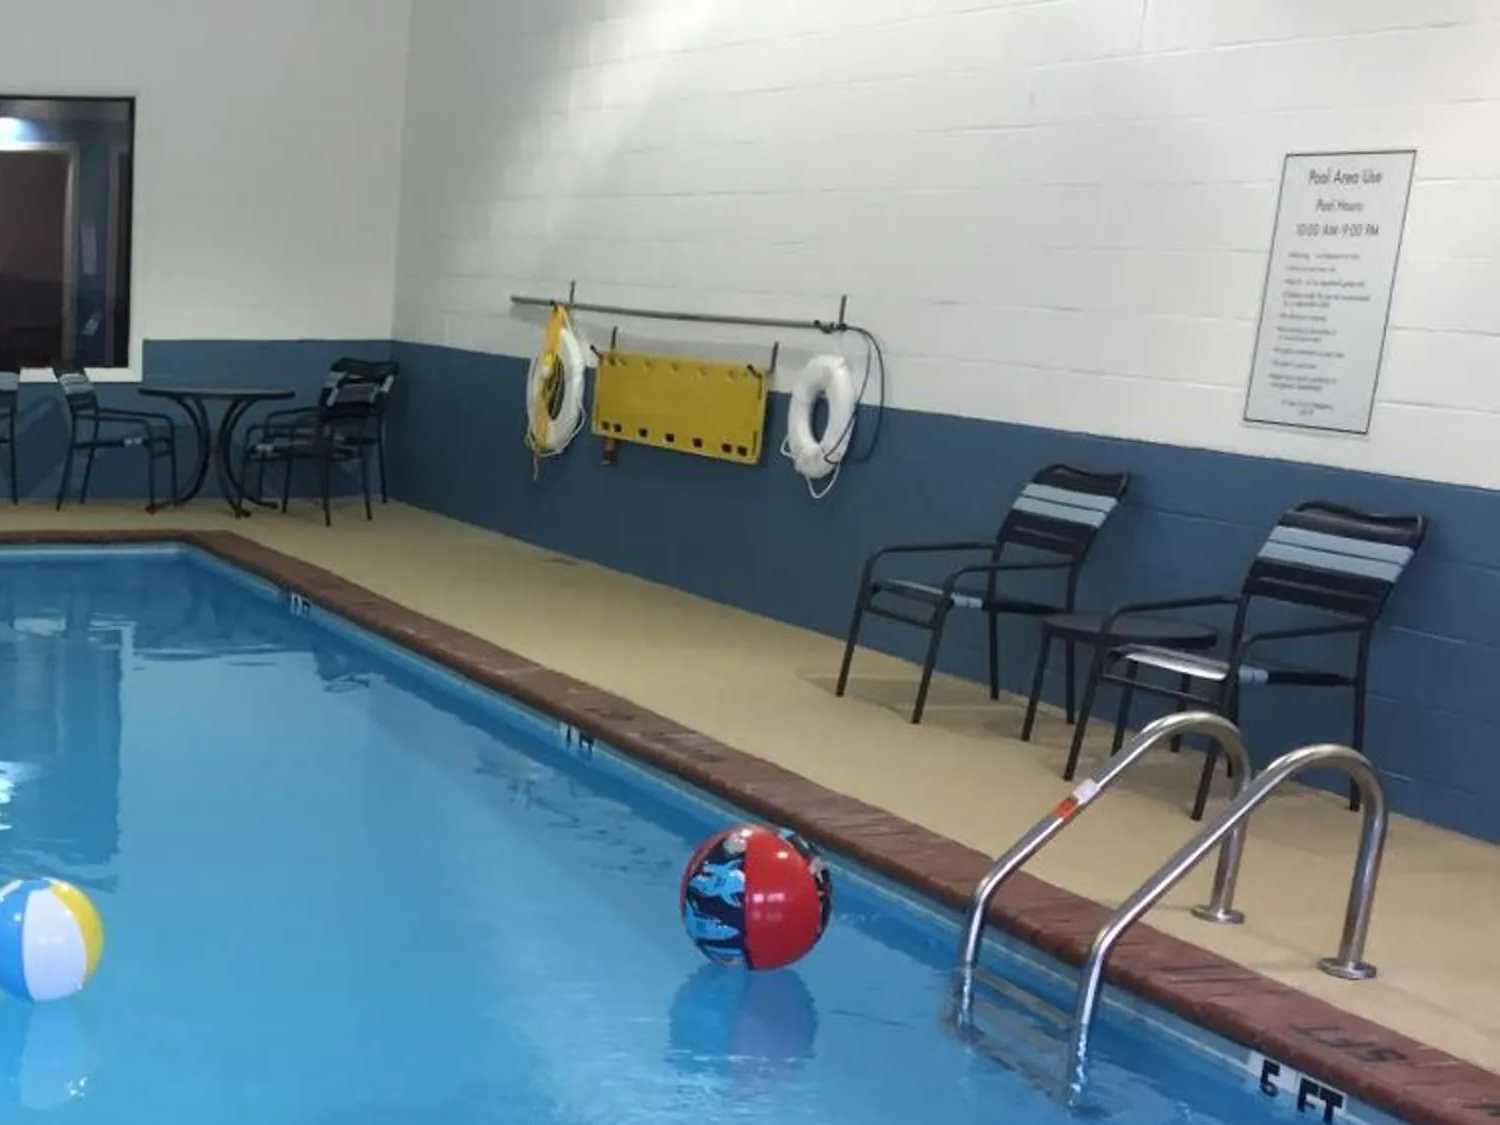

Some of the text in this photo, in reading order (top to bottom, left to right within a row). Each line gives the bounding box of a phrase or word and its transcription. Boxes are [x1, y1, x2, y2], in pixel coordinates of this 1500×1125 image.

[1308, 166, 1383, 185] Pool Area Use
[1297, 1077, 1344, 1125] FT
